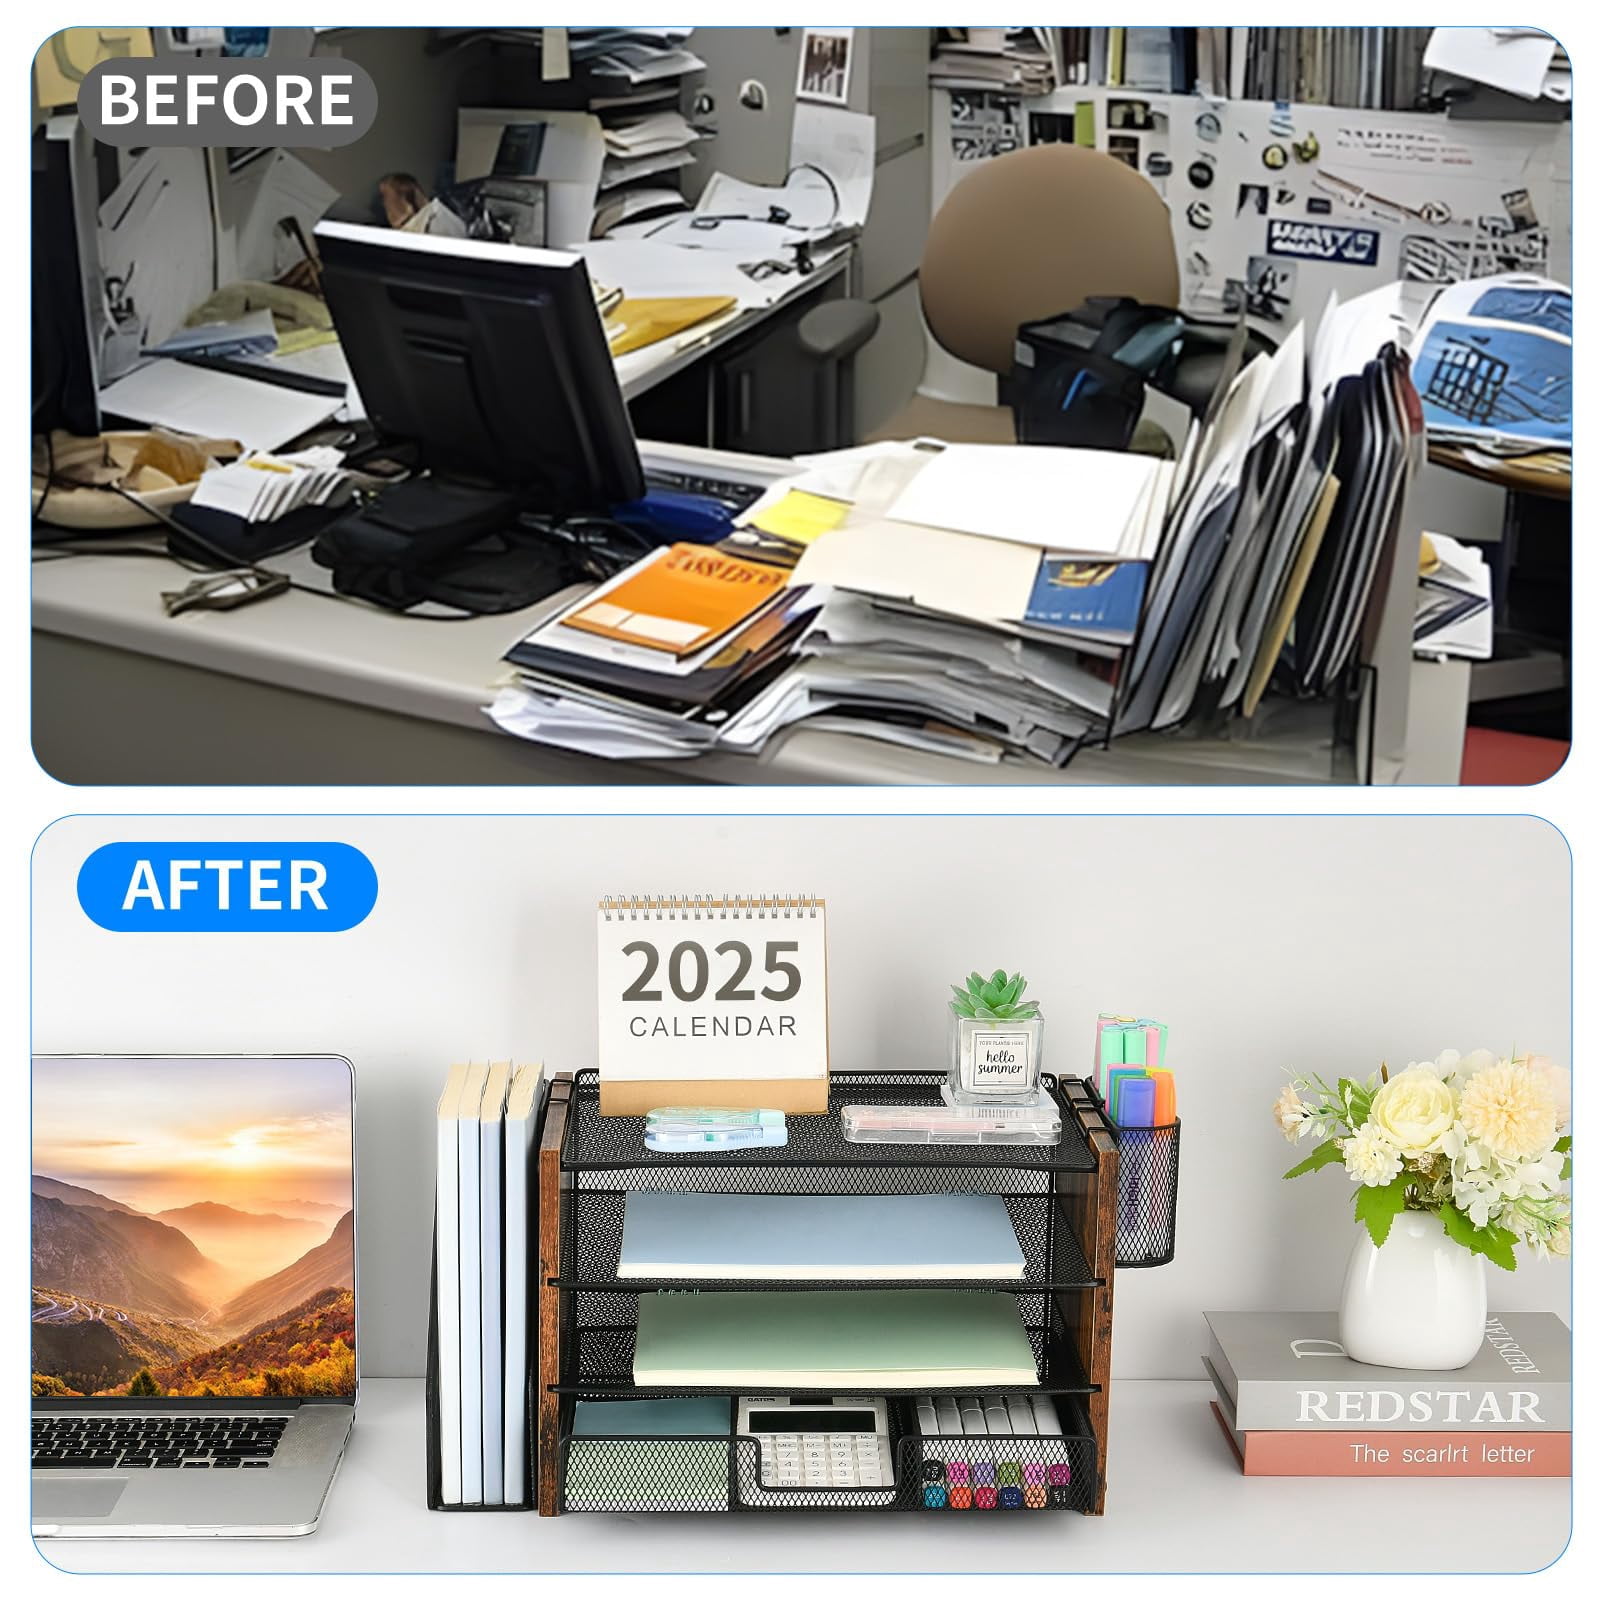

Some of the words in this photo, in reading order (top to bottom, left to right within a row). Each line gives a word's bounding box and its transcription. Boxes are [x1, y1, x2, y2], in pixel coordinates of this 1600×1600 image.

[622, 940, 801, 1002] 2025
[630, 1016, 796, 1037] CALENDAR
[986, 1050, 1015, 1063] hello
[978, 1064, 1023, 1075] summer
[1296, 1390, 1546, 1423] REDSTAR
[1350, 1444, 1390, 1463] The
[1402, 1444, 1468, 1463] scarlrt
[1482, 1444, 1535, 1463] letter
